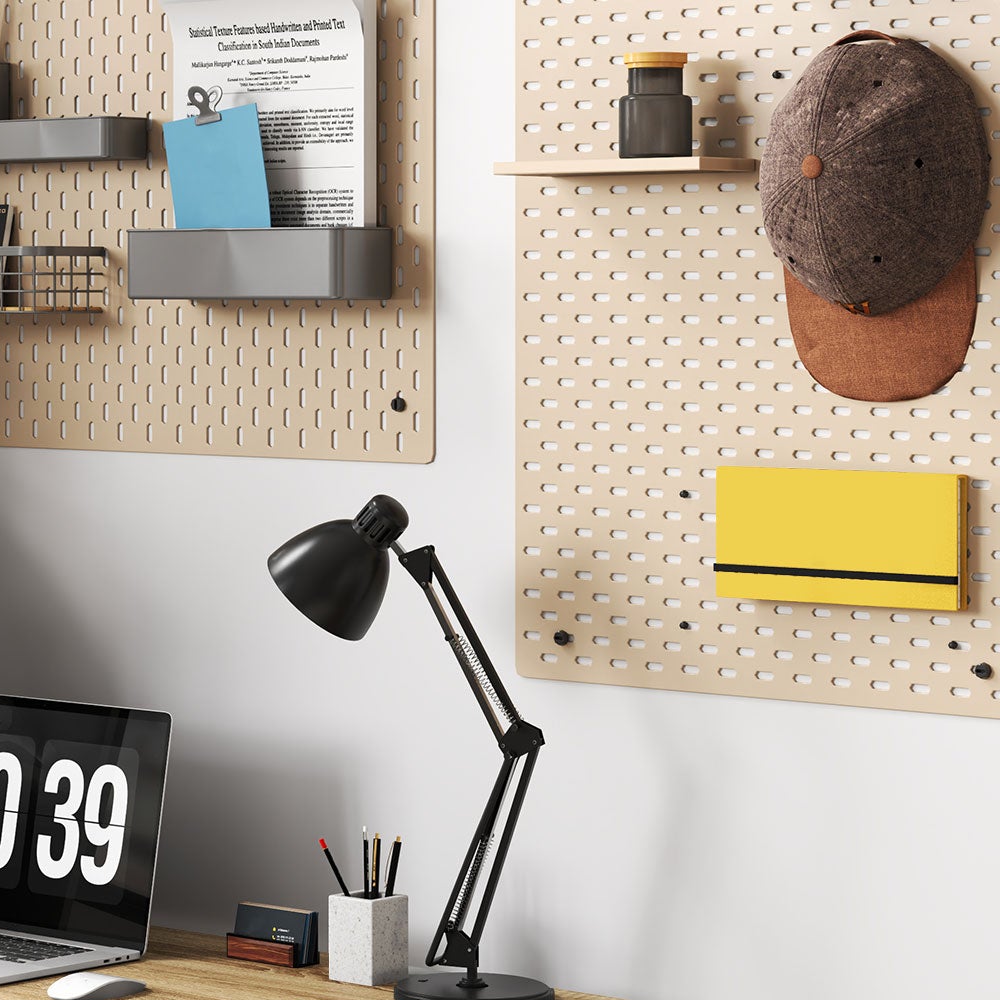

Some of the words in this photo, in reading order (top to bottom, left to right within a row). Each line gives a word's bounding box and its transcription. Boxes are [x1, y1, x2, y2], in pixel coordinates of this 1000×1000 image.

[189, 26, 213, 38] Statistical
[213, 25, 233, 36] Texture
[233, 24, 255, 35] Features
[255, 22, 270, 34] based
[270, 21, 302, 33] Handwritten
[303, 20, 312, 31] and
[313, 19, 332, 30] Printed
[332, 18, 345, 29] Text
[218, 41, 251, 51] Classification
[252, 40, 258, 49] in
[258, 39, 273, 49] South
[274, 39, 290, 48] Indian
[291, 38, 320, 47] Documents
[36, 758, 129, 886] 39
